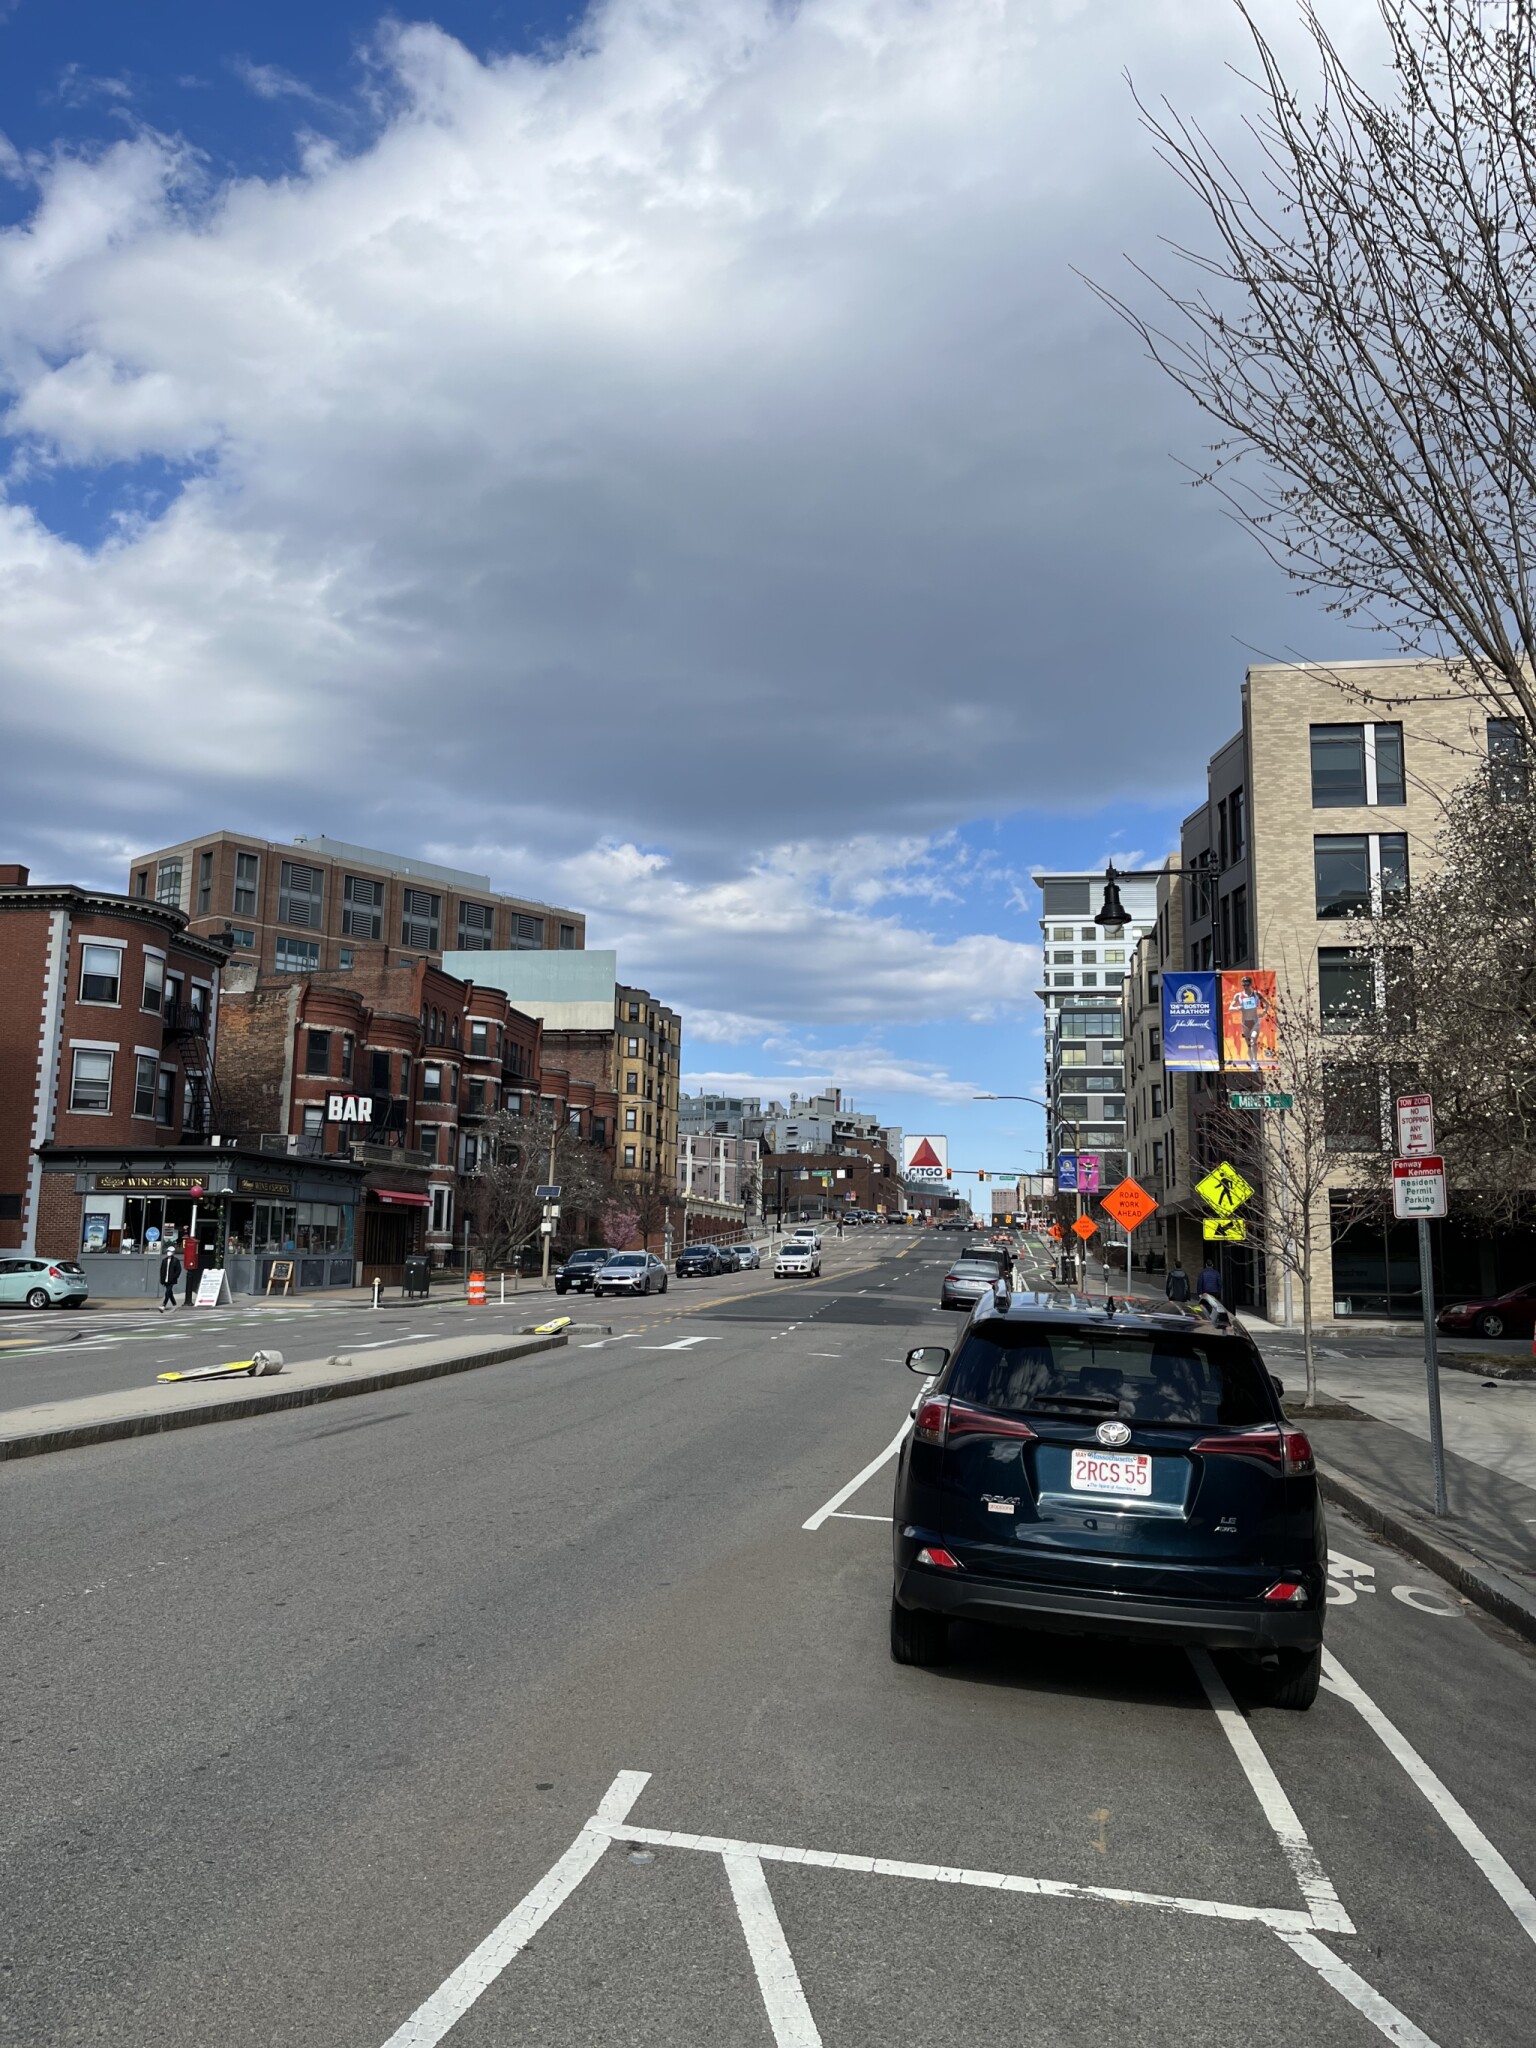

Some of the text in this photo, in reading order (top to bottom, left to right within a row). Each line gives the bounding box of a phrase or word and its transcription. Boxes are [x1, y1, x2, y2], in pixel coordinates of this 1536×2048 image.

[1400, 1097, 1430, 1107] TOW ZONE
[328, 1095, 373, 1122] BAR
[1402, 1116, 1430, 1125] STOPPING
[1394, 1161, 1422, 1170] Fenway
[909, 1168, 943, 1177] CITGO
[1408, 1168, 1442, 1176] Kenmore
[127, 1178, 155, 1186] WINE
[163, 1178, 202, 1186] SPIRITS
[1401, 1178, 1437, 1187] Resident
[1406, 1187, 1432, 1195] Permit
[1405, 1196, 1435, 1205] Parking
[1091, 1452, 1134, 1462] Massachusetts
[1077, 1460, 1147, 1485] 2RCS 55
[980, 1494, 1020, 1505] RAV4
